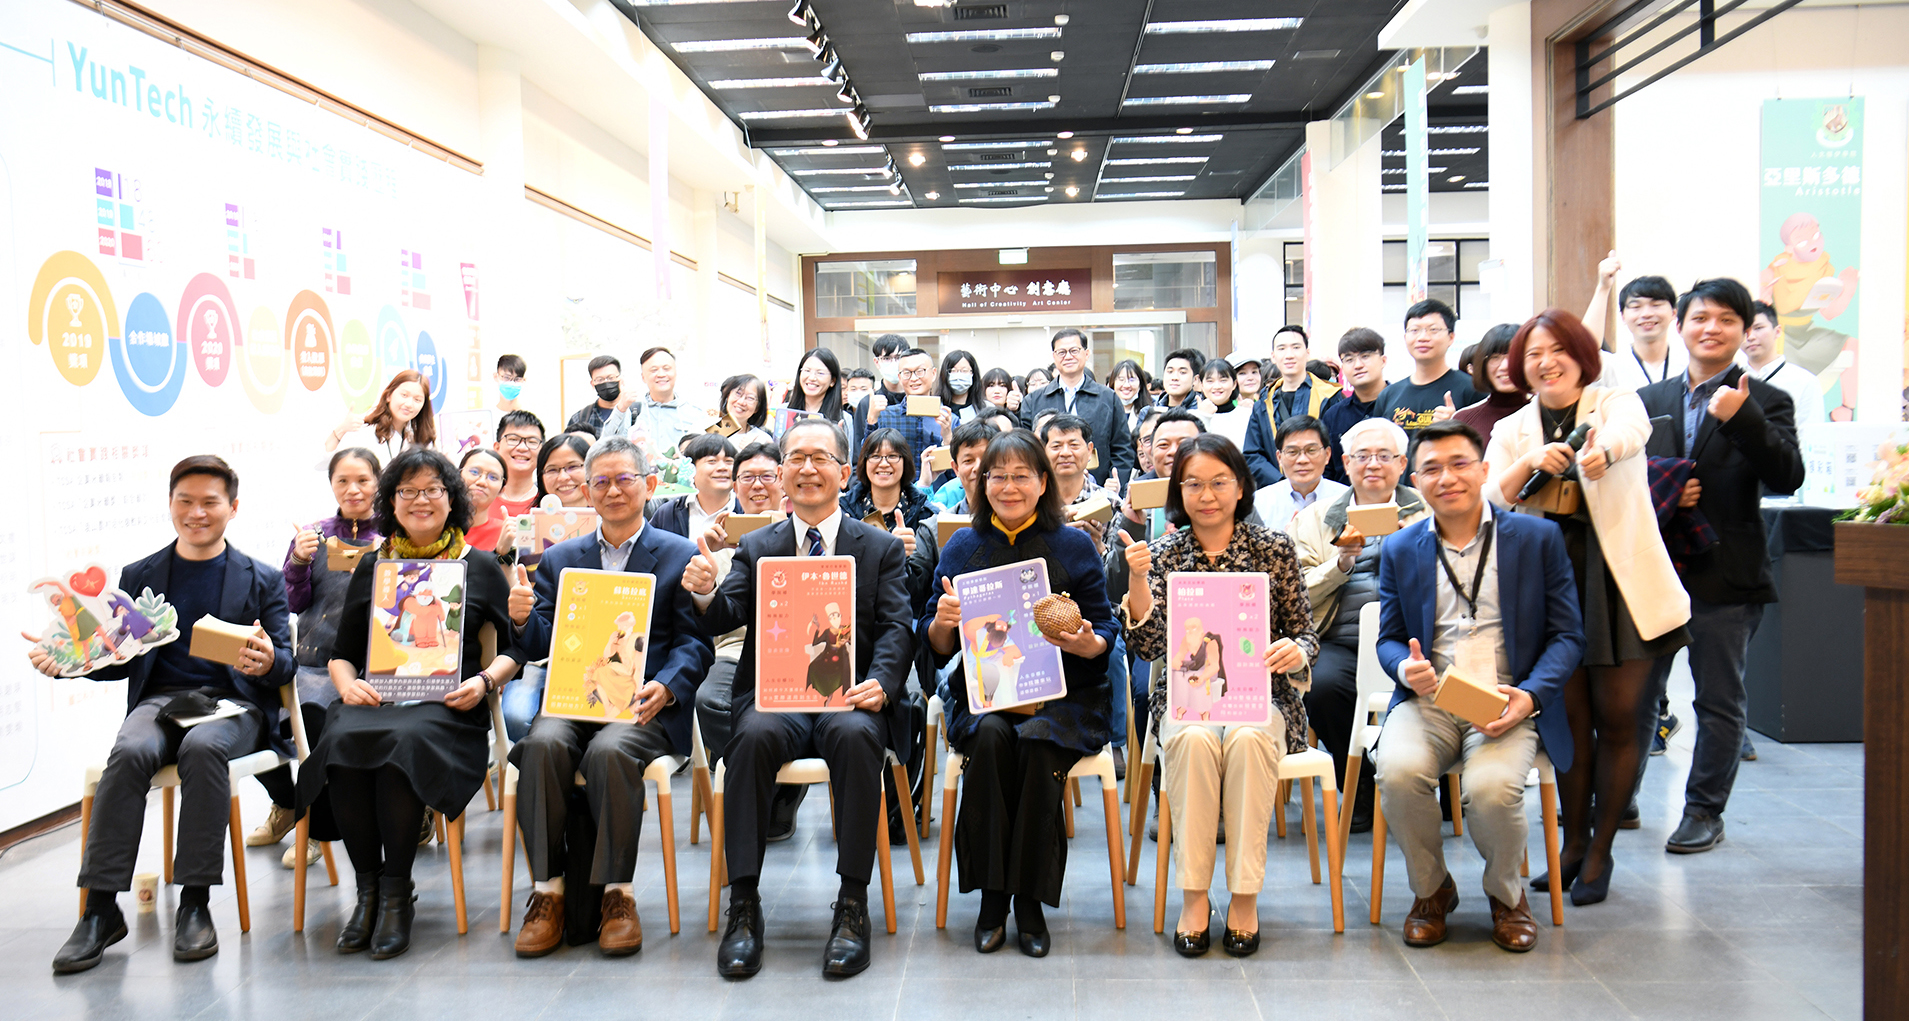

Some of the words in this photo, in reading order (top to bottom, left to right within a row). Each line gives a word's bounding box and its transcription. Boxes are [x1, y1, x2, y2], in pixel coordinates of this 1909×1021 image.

[66, 40, 194, 129] YunTech
[1763, 165, 1861, 187] 亞里斯多德
[1795, 186, 1861, 197] Aristotle
[960, 282, 1019, 299] 藝術中心
[990, 300, 1027, 308] Creativity
[61, 332, 93, 350] 2019
[200, 340, 224, 356] 2020
[613, 586, 647, 597] 蘇格拉底
[1177, 587, 1204, 597] 柏拉圖
